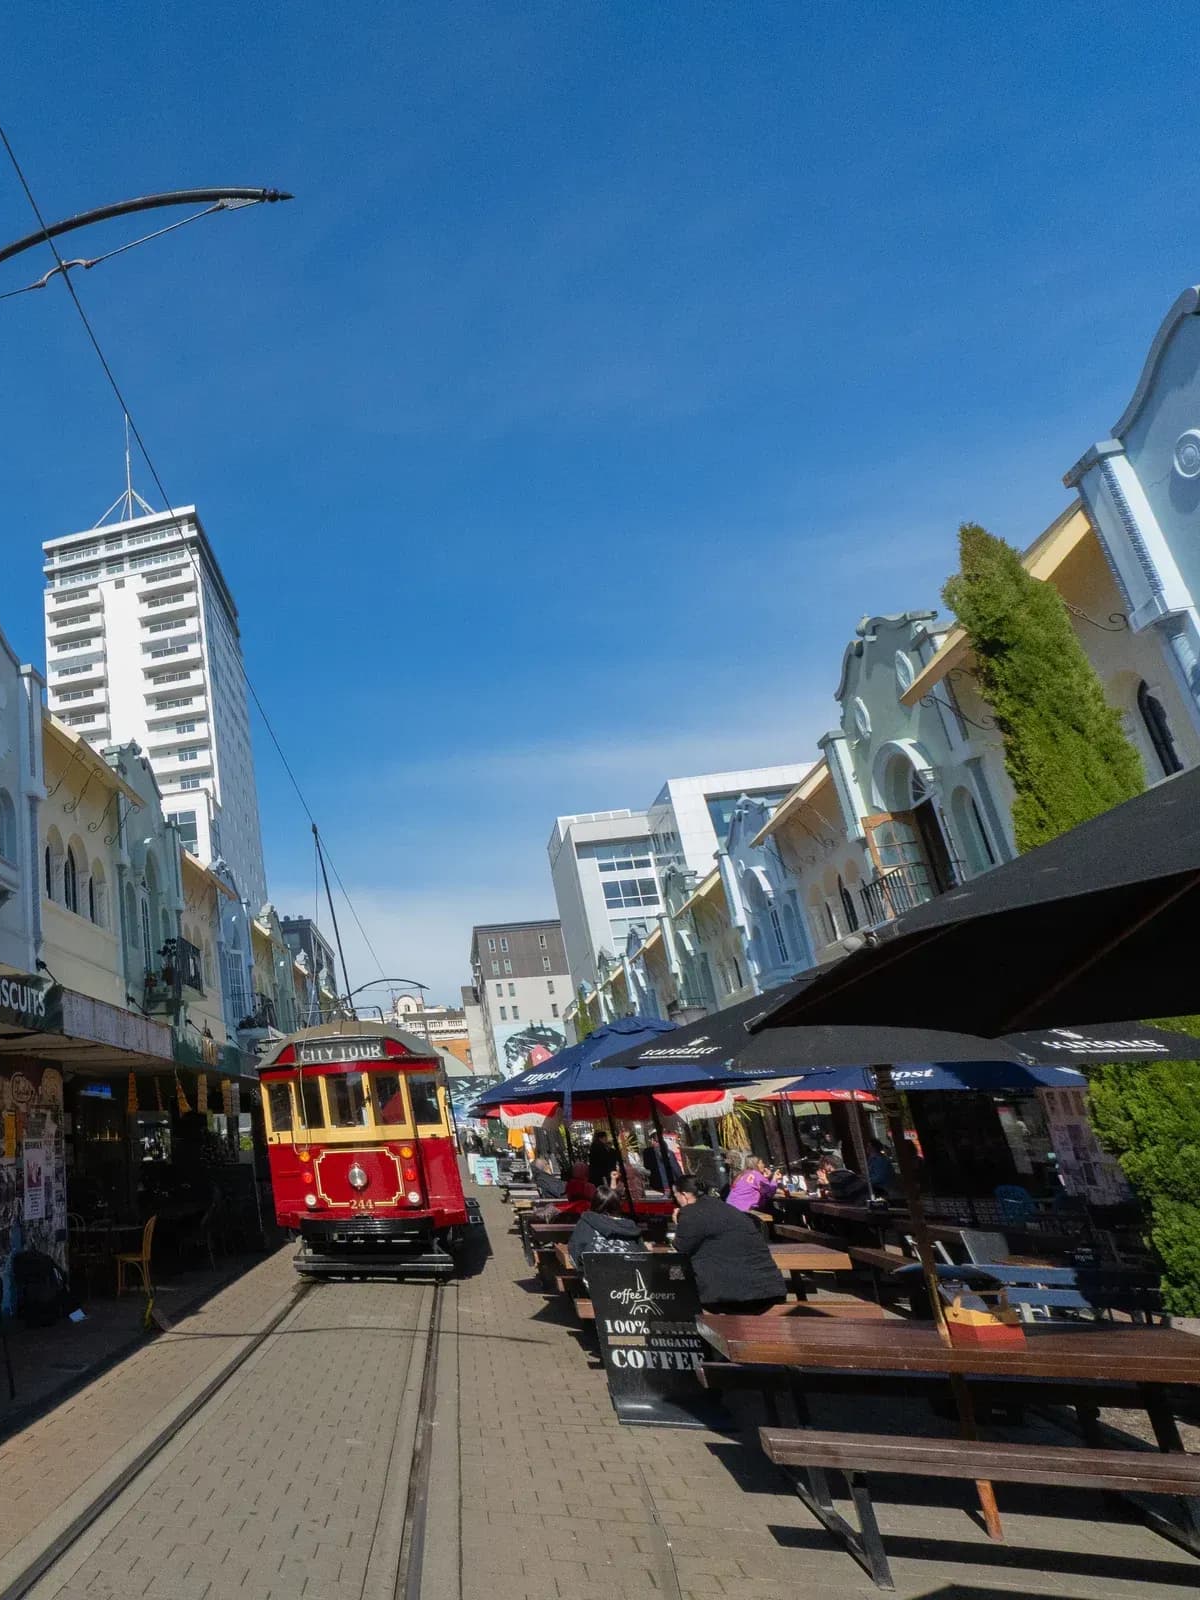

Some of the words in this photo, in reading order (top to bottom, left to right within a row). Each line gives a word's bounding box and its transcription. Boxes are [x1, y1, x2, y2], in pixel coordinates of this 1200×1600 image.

[301, 1047, 333, 1061] CITY
[341, 1044, 381, 1061] TOUR
[350, 1199, 374, 1209] 244
[610, 1288, 641, 1305] Coffee
[643, 1290, 677, 1301] Lovers
[604, 1319, 650, 1335] 100%
[651, 1337, 702, 1348] ORGANIC
[611, 1349, 704, 1371] COFFEE
